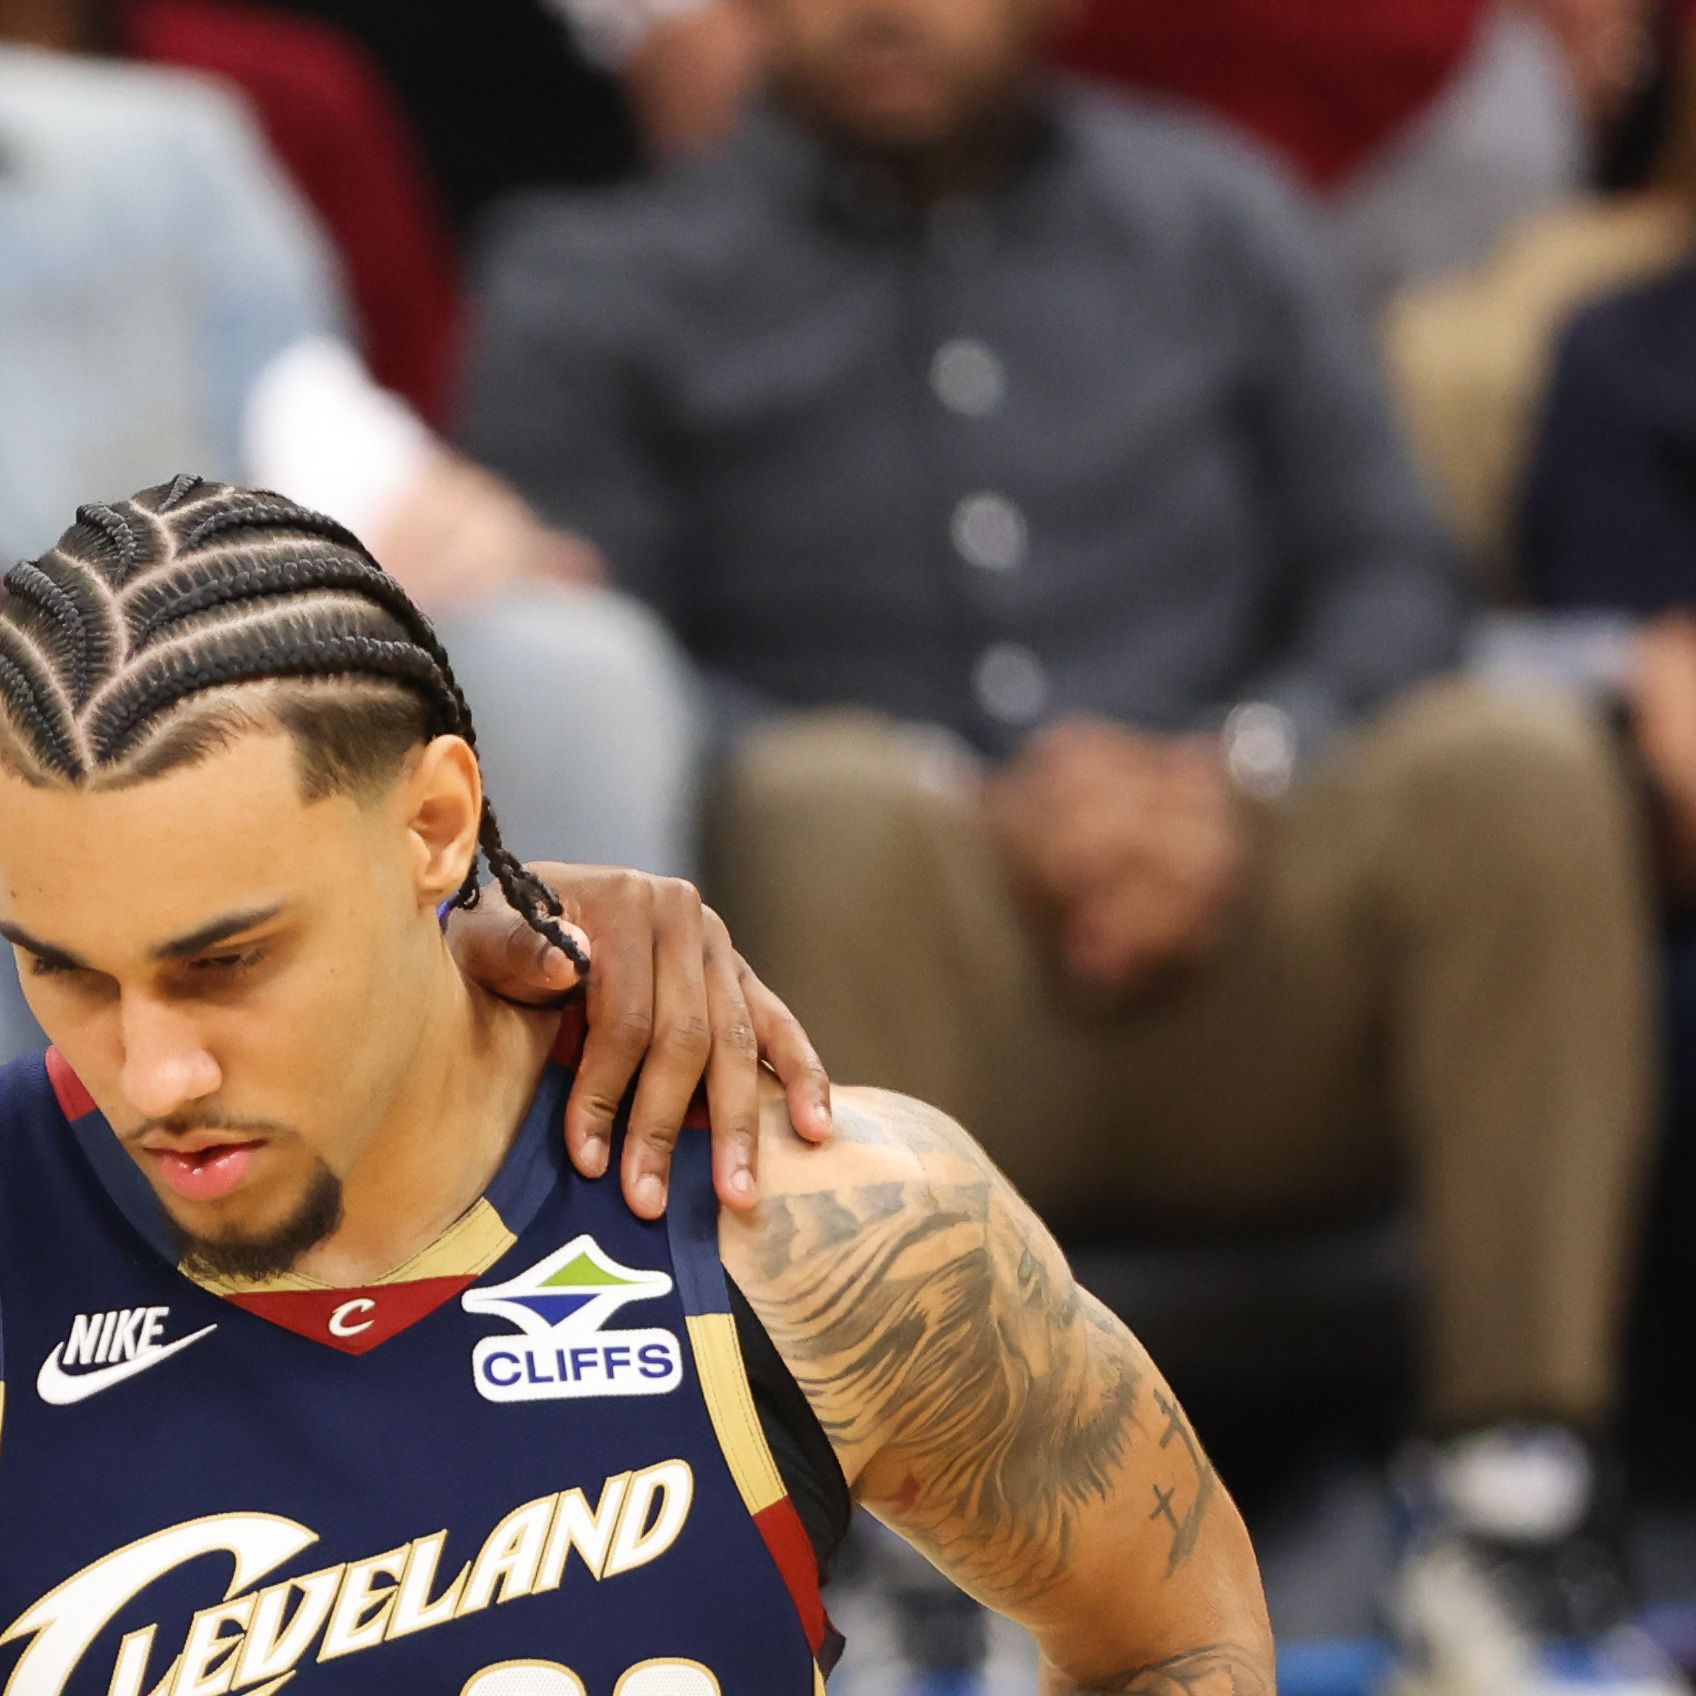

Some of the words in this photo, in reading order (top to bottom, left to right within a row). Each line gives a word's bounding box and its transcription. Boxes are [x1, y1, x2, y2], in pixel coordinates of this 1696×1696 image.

[62, 1306, 170, 1365] NIKE
[328, 1298, 376, 1337] C
[481, 1343, 675, 1387] CLIFFS
